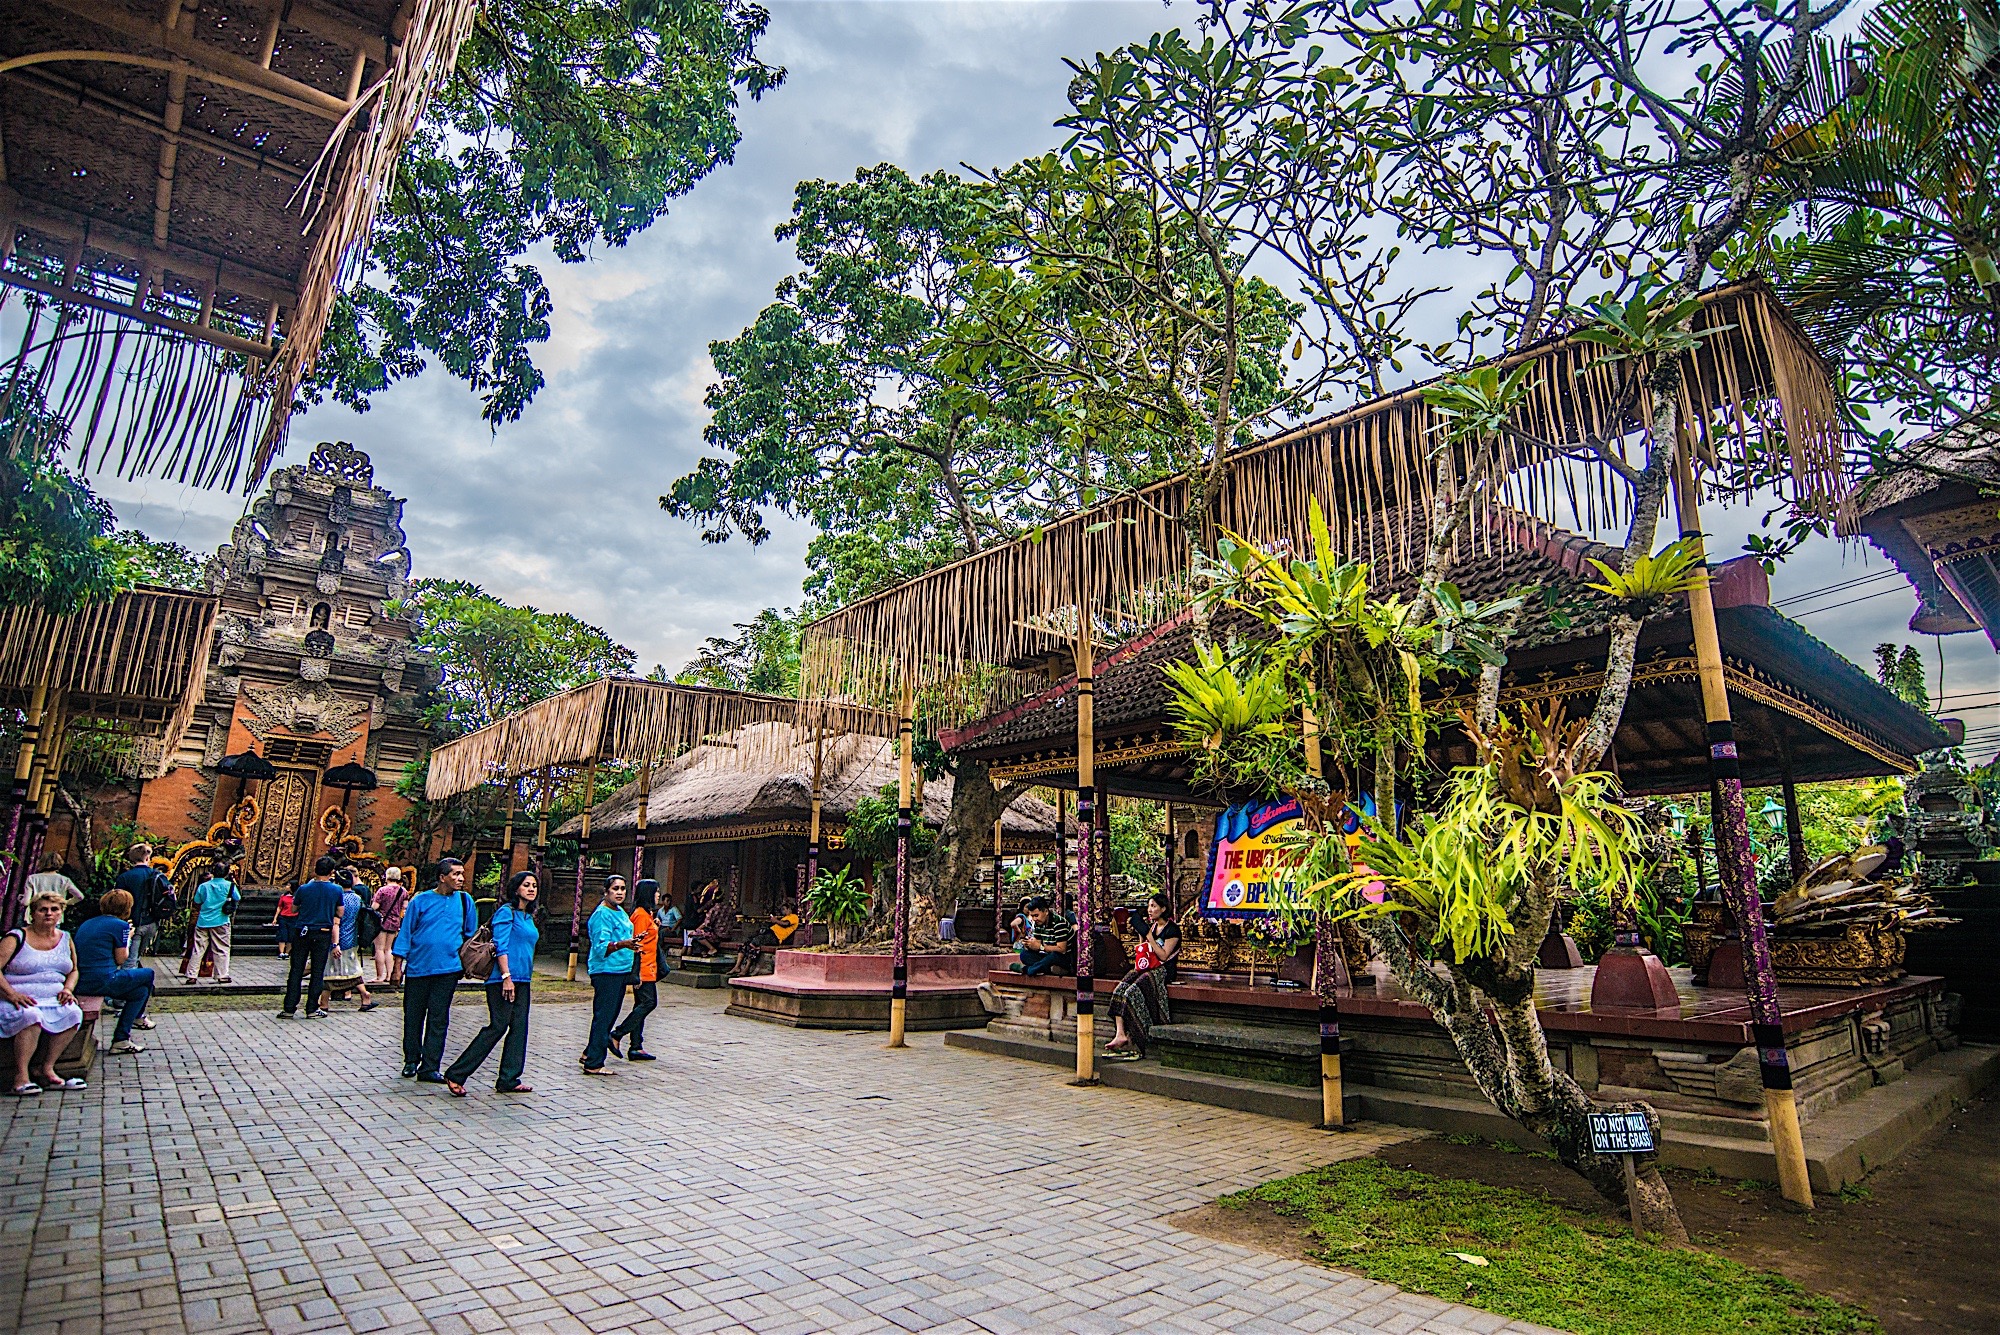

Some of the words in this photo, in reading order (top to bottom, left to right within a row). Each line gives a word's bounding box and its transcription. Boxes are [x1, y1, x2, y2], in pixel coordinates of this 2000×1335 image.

[1224, 850, 1244, 870] THE
[1246, 849, 1275, 868] UBUD
[1593, 1117, 1607, 1132] DO
[1608, 1116, 1626, 1132] NOT
[1625, 1116, 1647, 1131] WALK
[1594, 1133, 1609, 1148] ON
[1610, 1133, 1628, 1148] THE
[1628, 1131, 1651, 1148] GRASS
